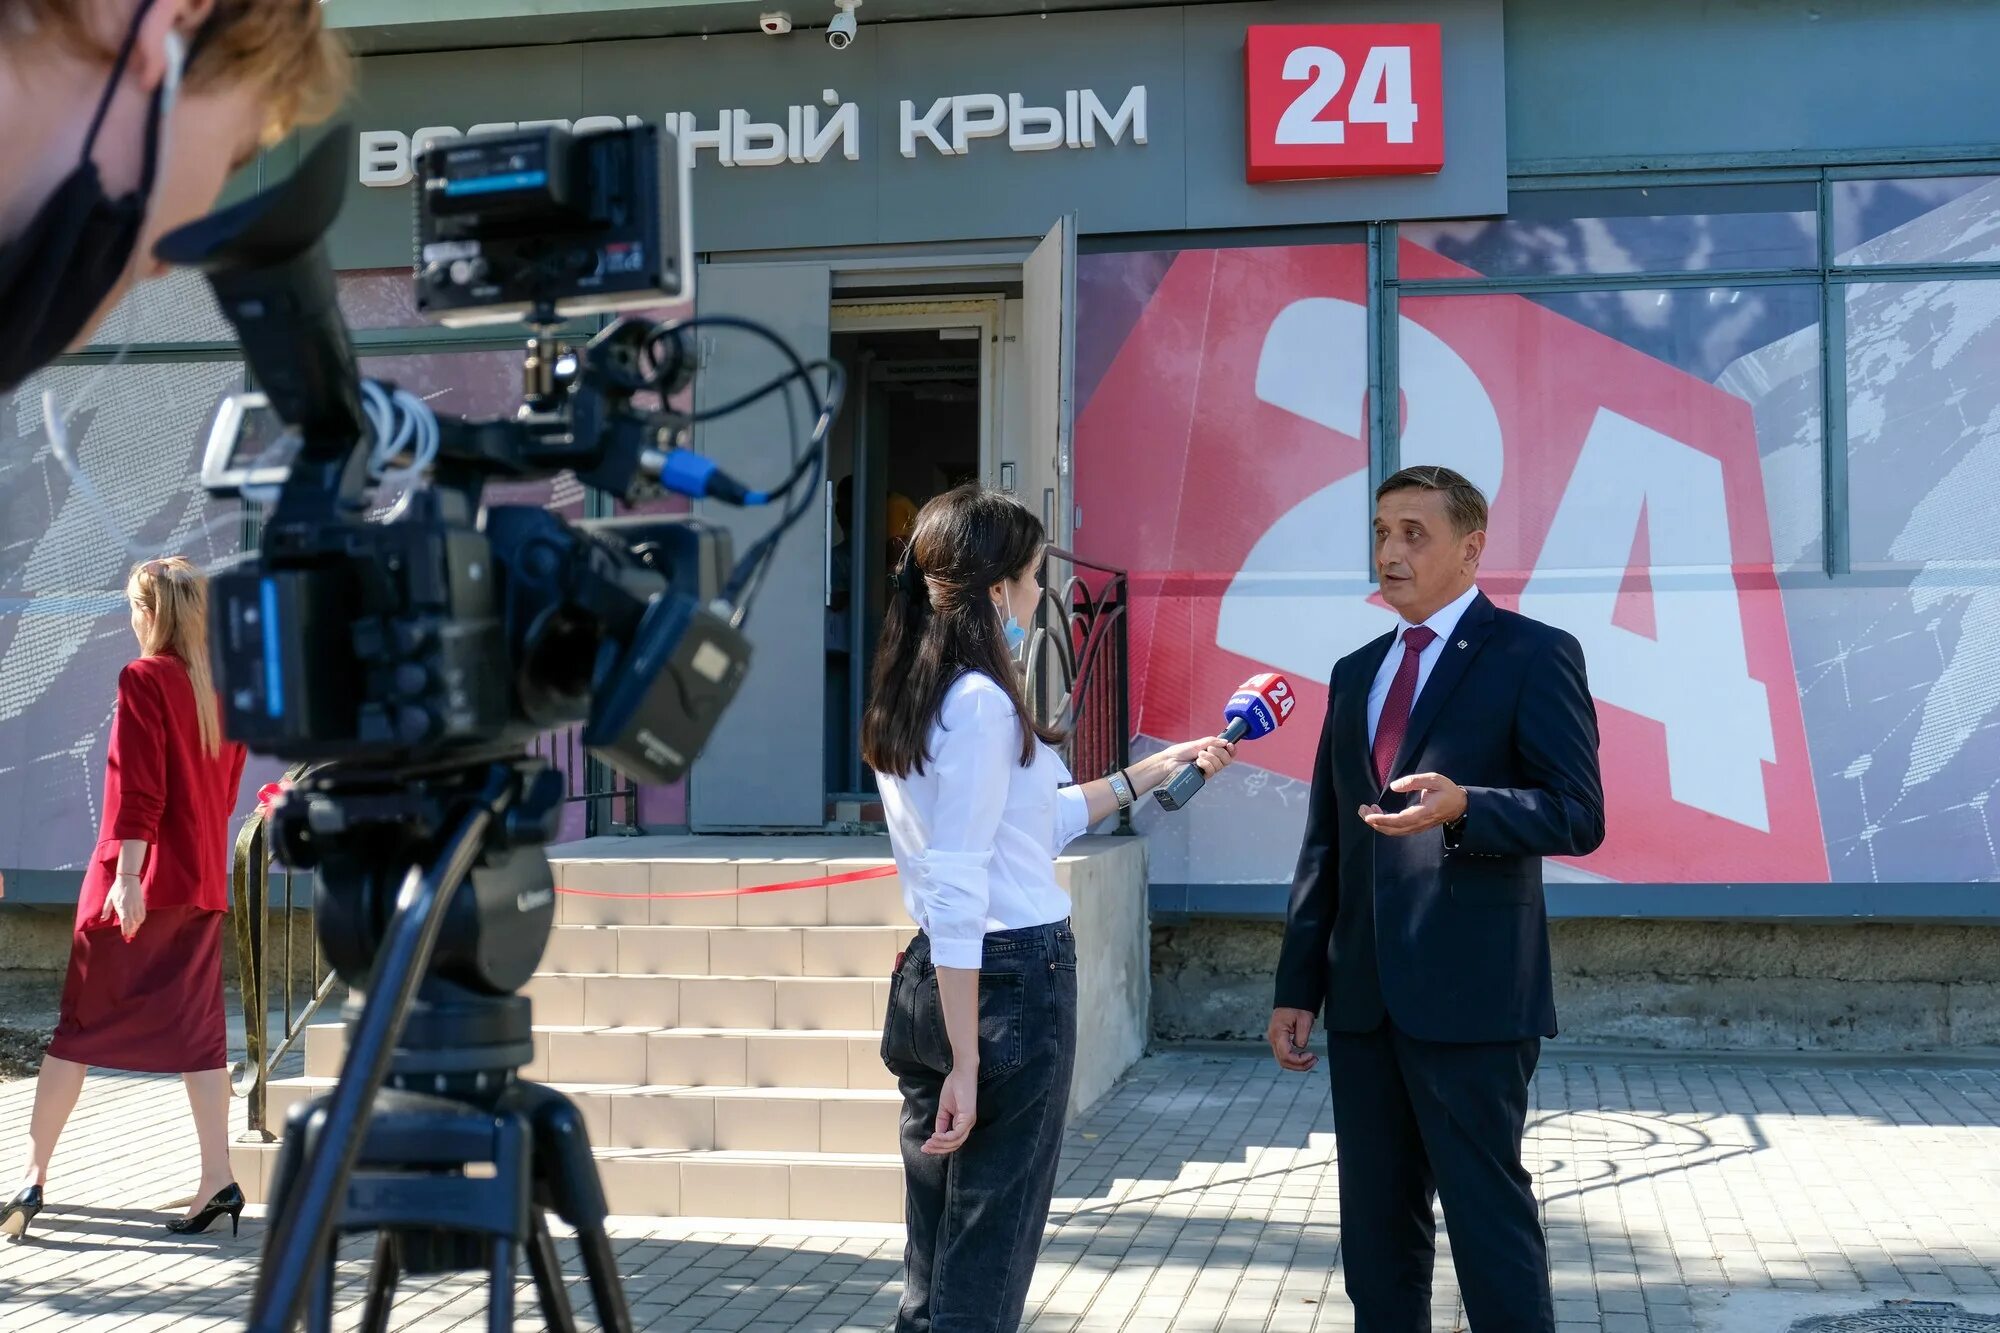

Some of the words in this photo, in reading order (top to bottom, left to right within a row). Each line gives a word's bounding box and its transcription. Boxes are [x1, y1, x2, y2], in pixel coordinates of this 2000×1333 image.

[900, 85, 1148, 158] КРЫМ
[1274, 45, 1418, 145] 24
[1215, 297, 1776, 833] 24
[1252, 705, 1271, 732] КРЫМ
[1268, 681, 1295, 718] 24
